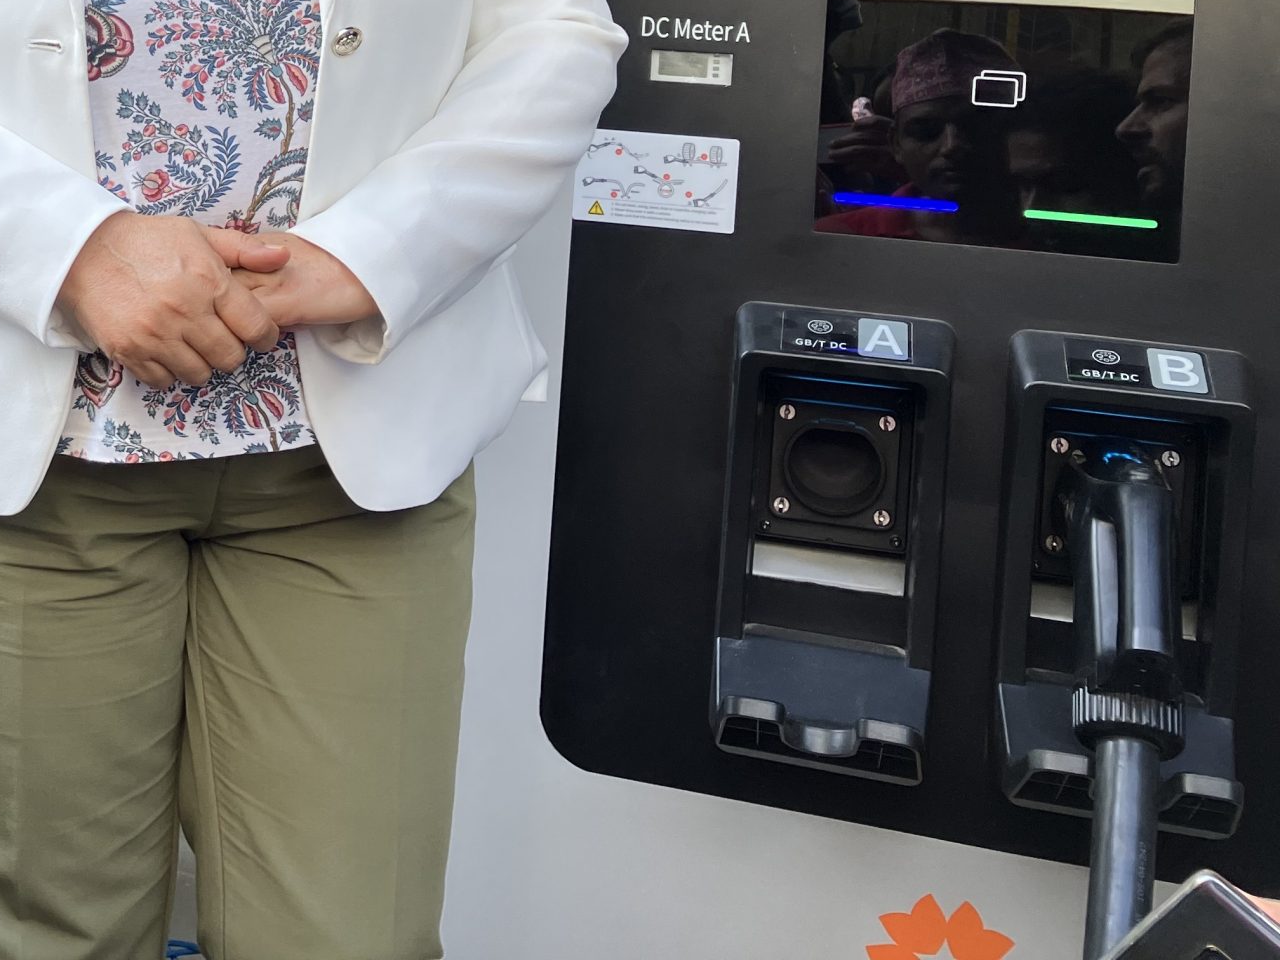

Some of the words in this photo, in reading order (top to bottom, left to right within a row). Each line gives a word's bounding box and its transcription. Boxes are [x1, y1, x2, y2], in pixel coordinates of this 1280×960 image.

[641, 15, 670, 38] DC
[674, 18, 734, 42] Meter
[735, 21, 751, 43] A
[795, 337, 826, 348] GB/T
[829, 341, 847, 350] DC
[863, 324, 904, 356] A
[1081, 368, 1116, 380] GB/T
[1119, 372, 1140, 382] DC
[1157, 353, 1200, 387] B
